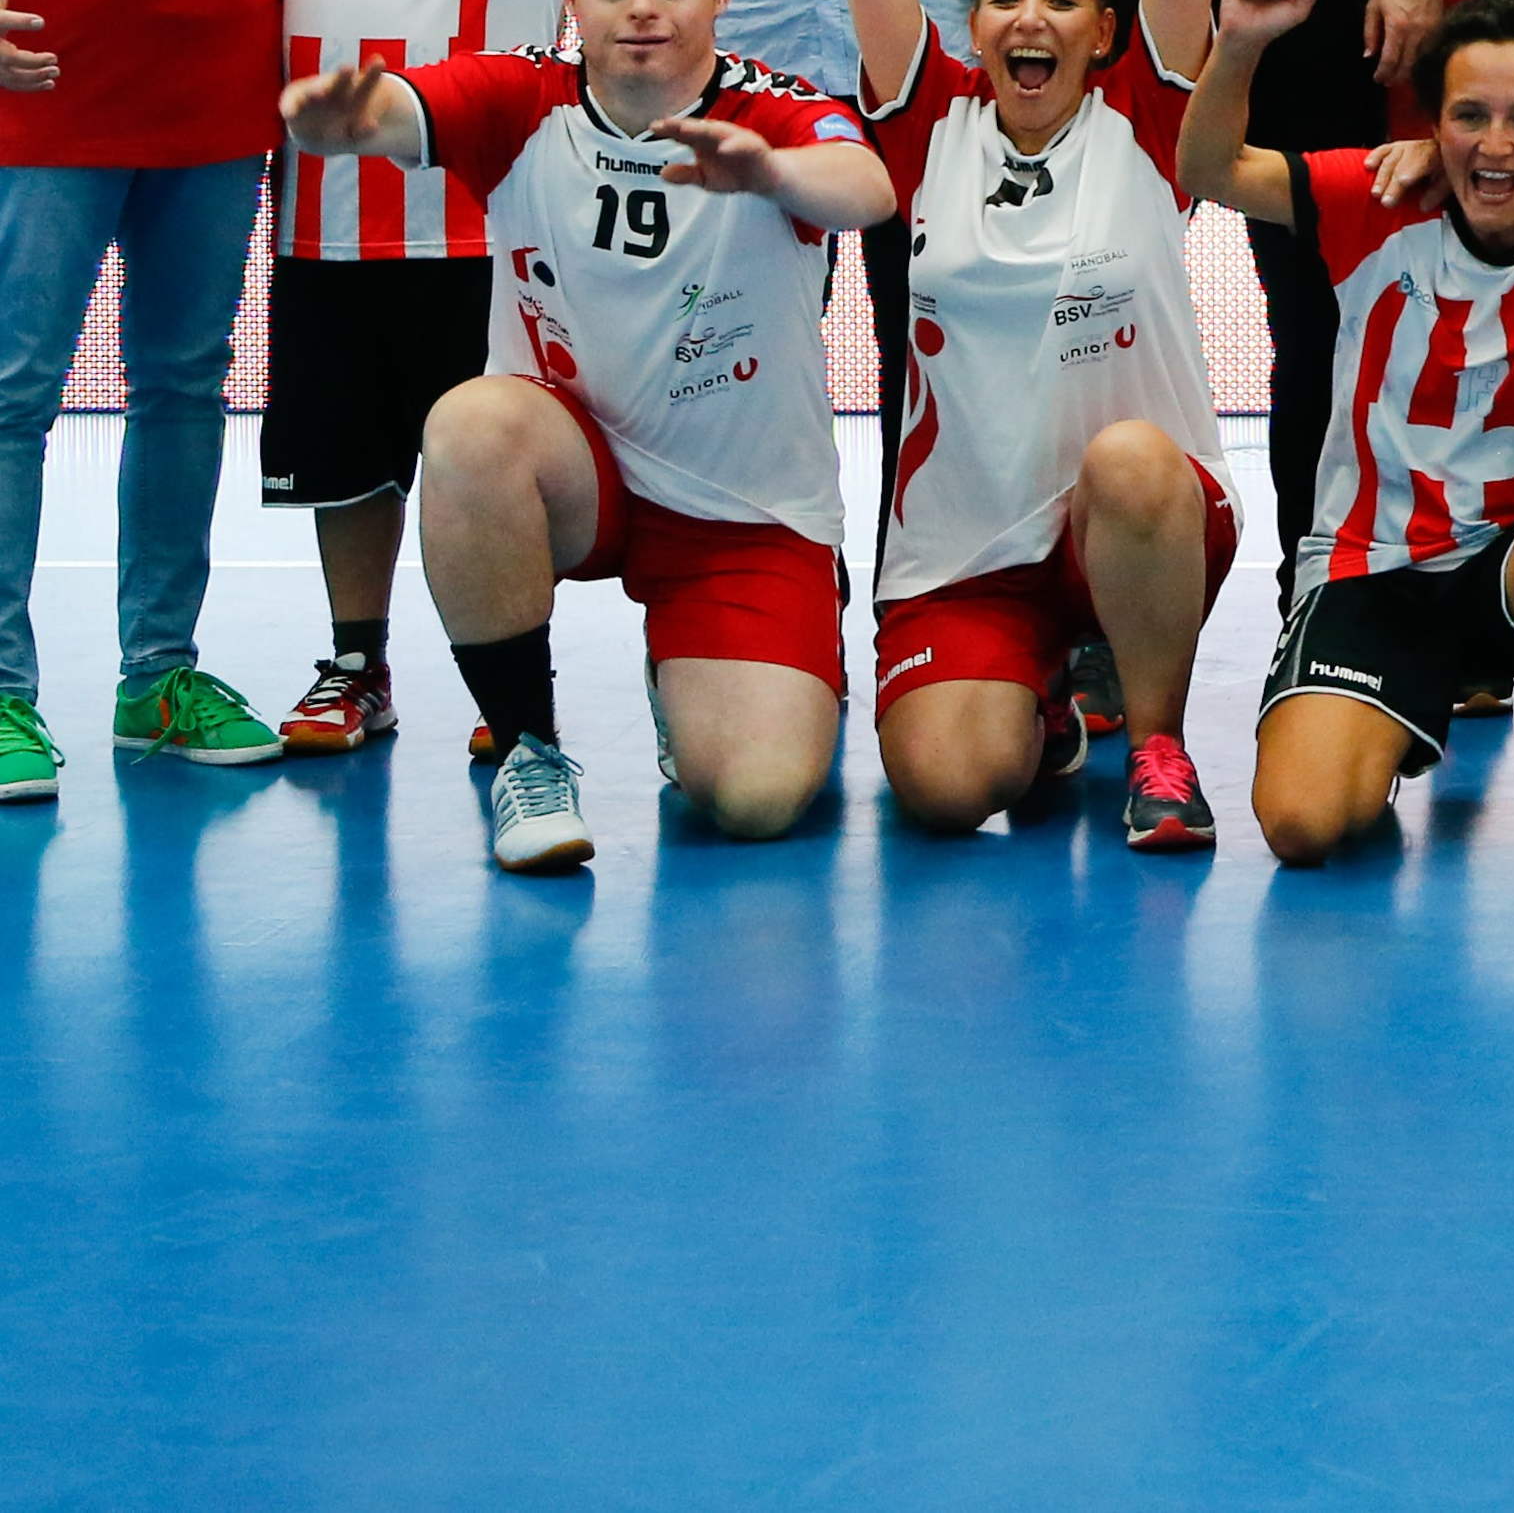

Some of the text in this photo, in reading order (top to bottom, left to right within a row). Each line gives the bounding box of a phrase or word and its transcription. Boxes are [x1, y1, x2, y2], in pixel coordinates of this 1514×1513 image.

[592, 183, 671, 259] 19
[1054, 302, 1093, 327] BSV
[669, 373, 729, 399] union
[1309, 660, 1383, 692] hummel
